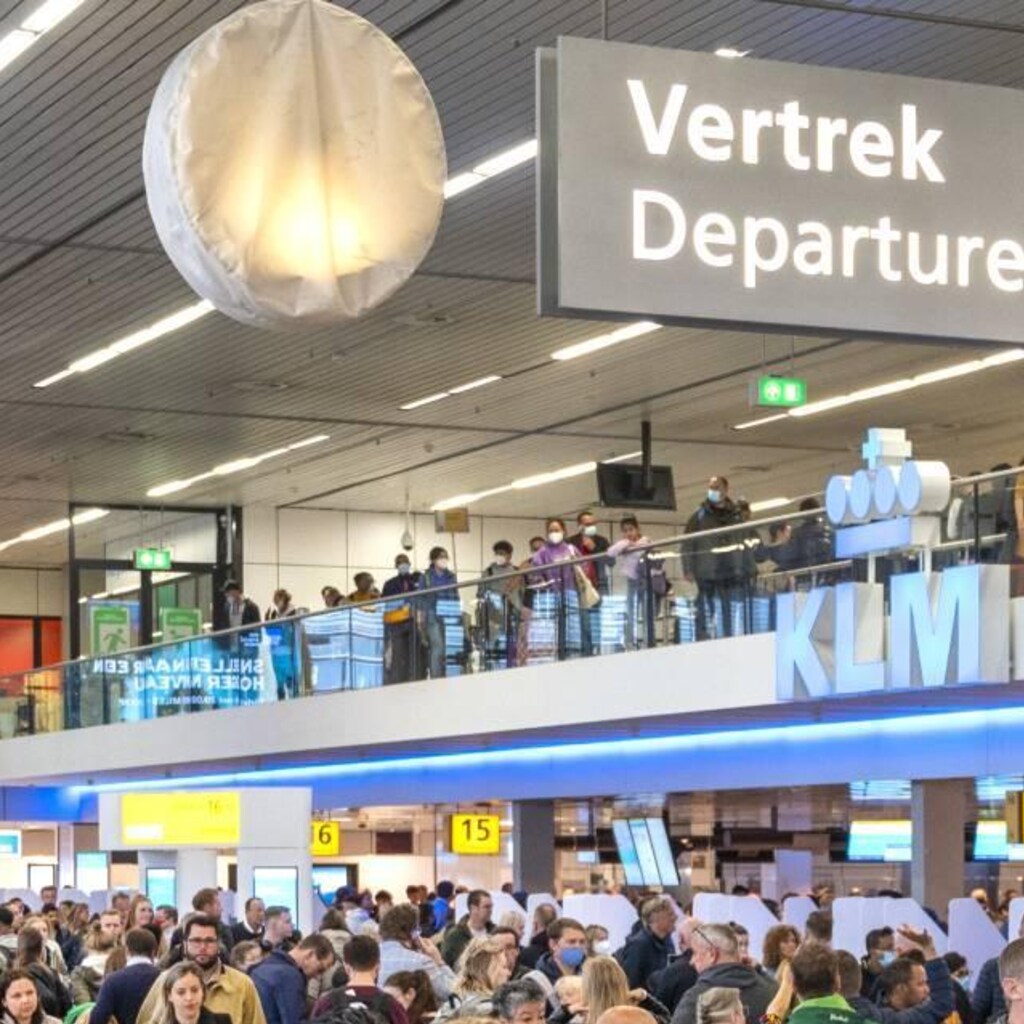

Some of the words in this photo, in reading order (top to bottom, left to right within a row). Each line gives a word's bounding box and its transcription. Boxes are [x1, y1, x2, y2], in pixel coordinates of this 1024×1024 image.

[626, 78, 946, 184] Vertrek
[776, 564, 981, 700] KLM
[462, 818, 490, 842] 15
